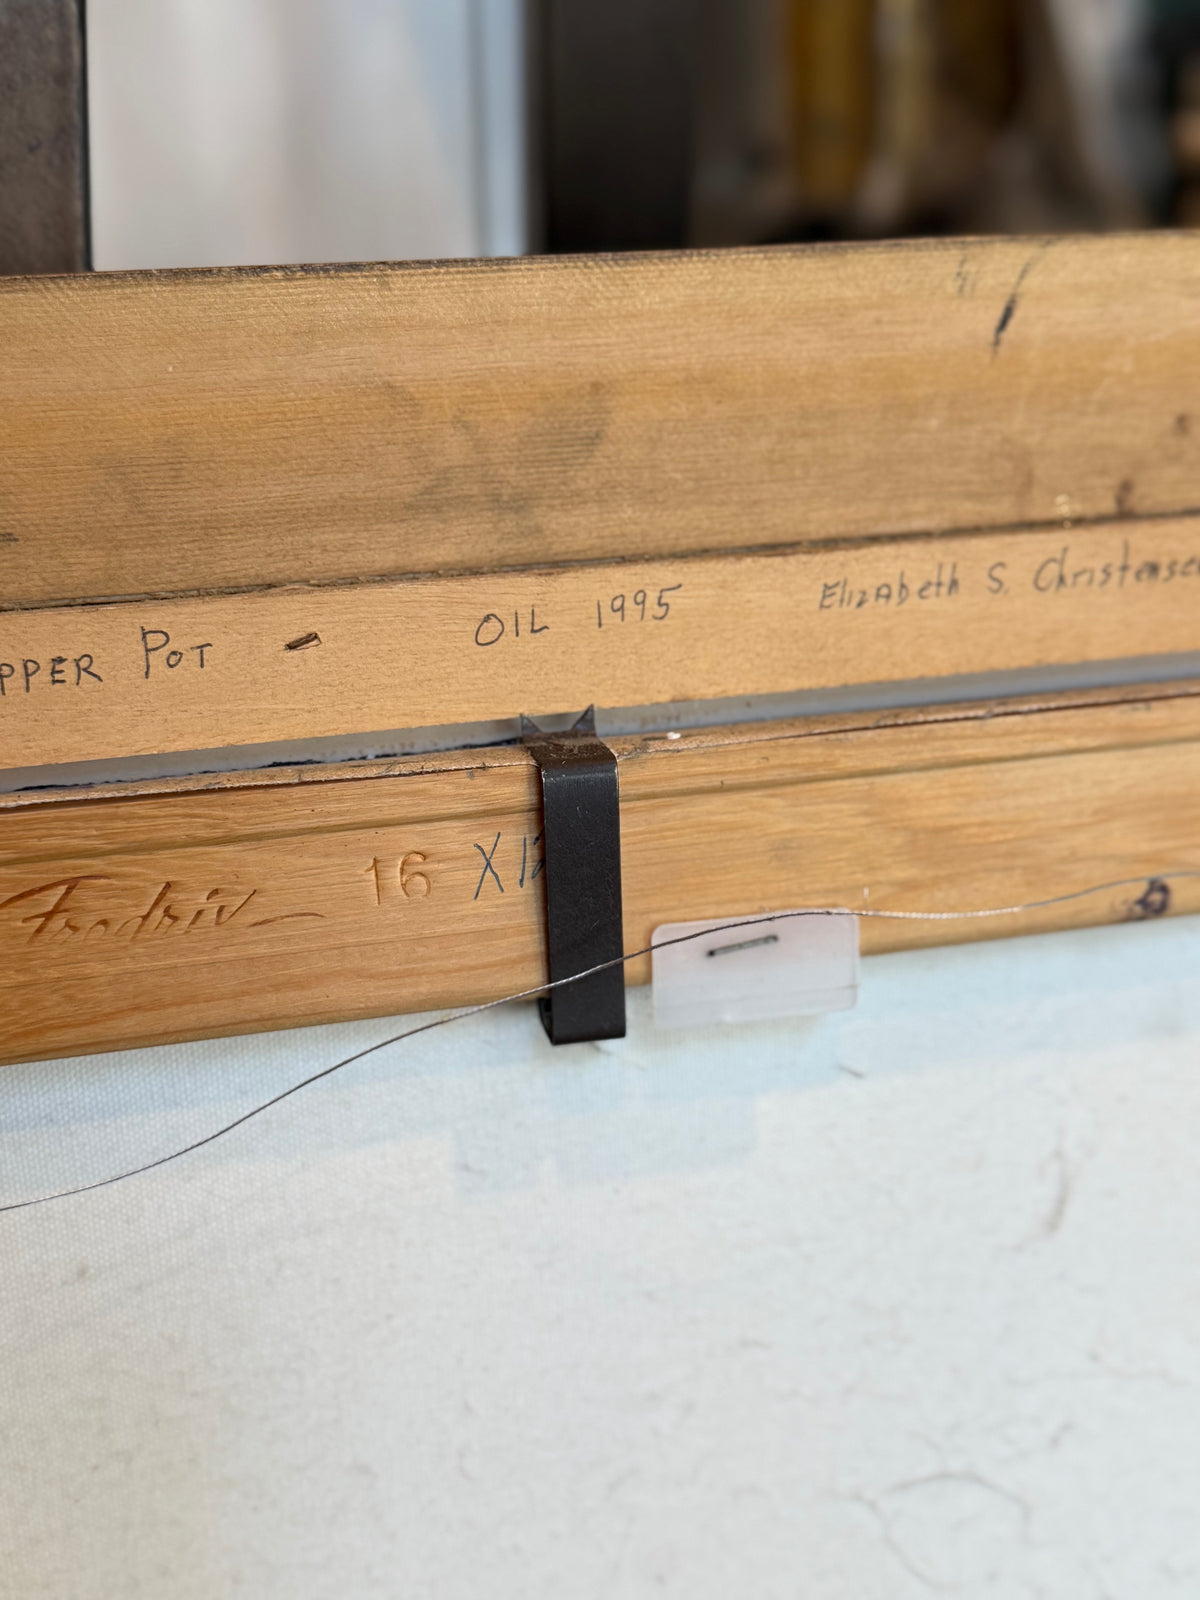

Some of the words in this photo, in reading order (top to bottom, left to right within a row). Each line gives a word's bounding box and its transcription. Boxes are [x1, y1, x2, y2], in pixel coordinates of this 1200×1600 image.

[0, 654, 103, 696] PPER
[475, 604, 549, 647] OIL
[597, 583, 683, 629] 1995
[1032, 538, 1200, 593] Christense
[364, 850, 431, 906] 16
